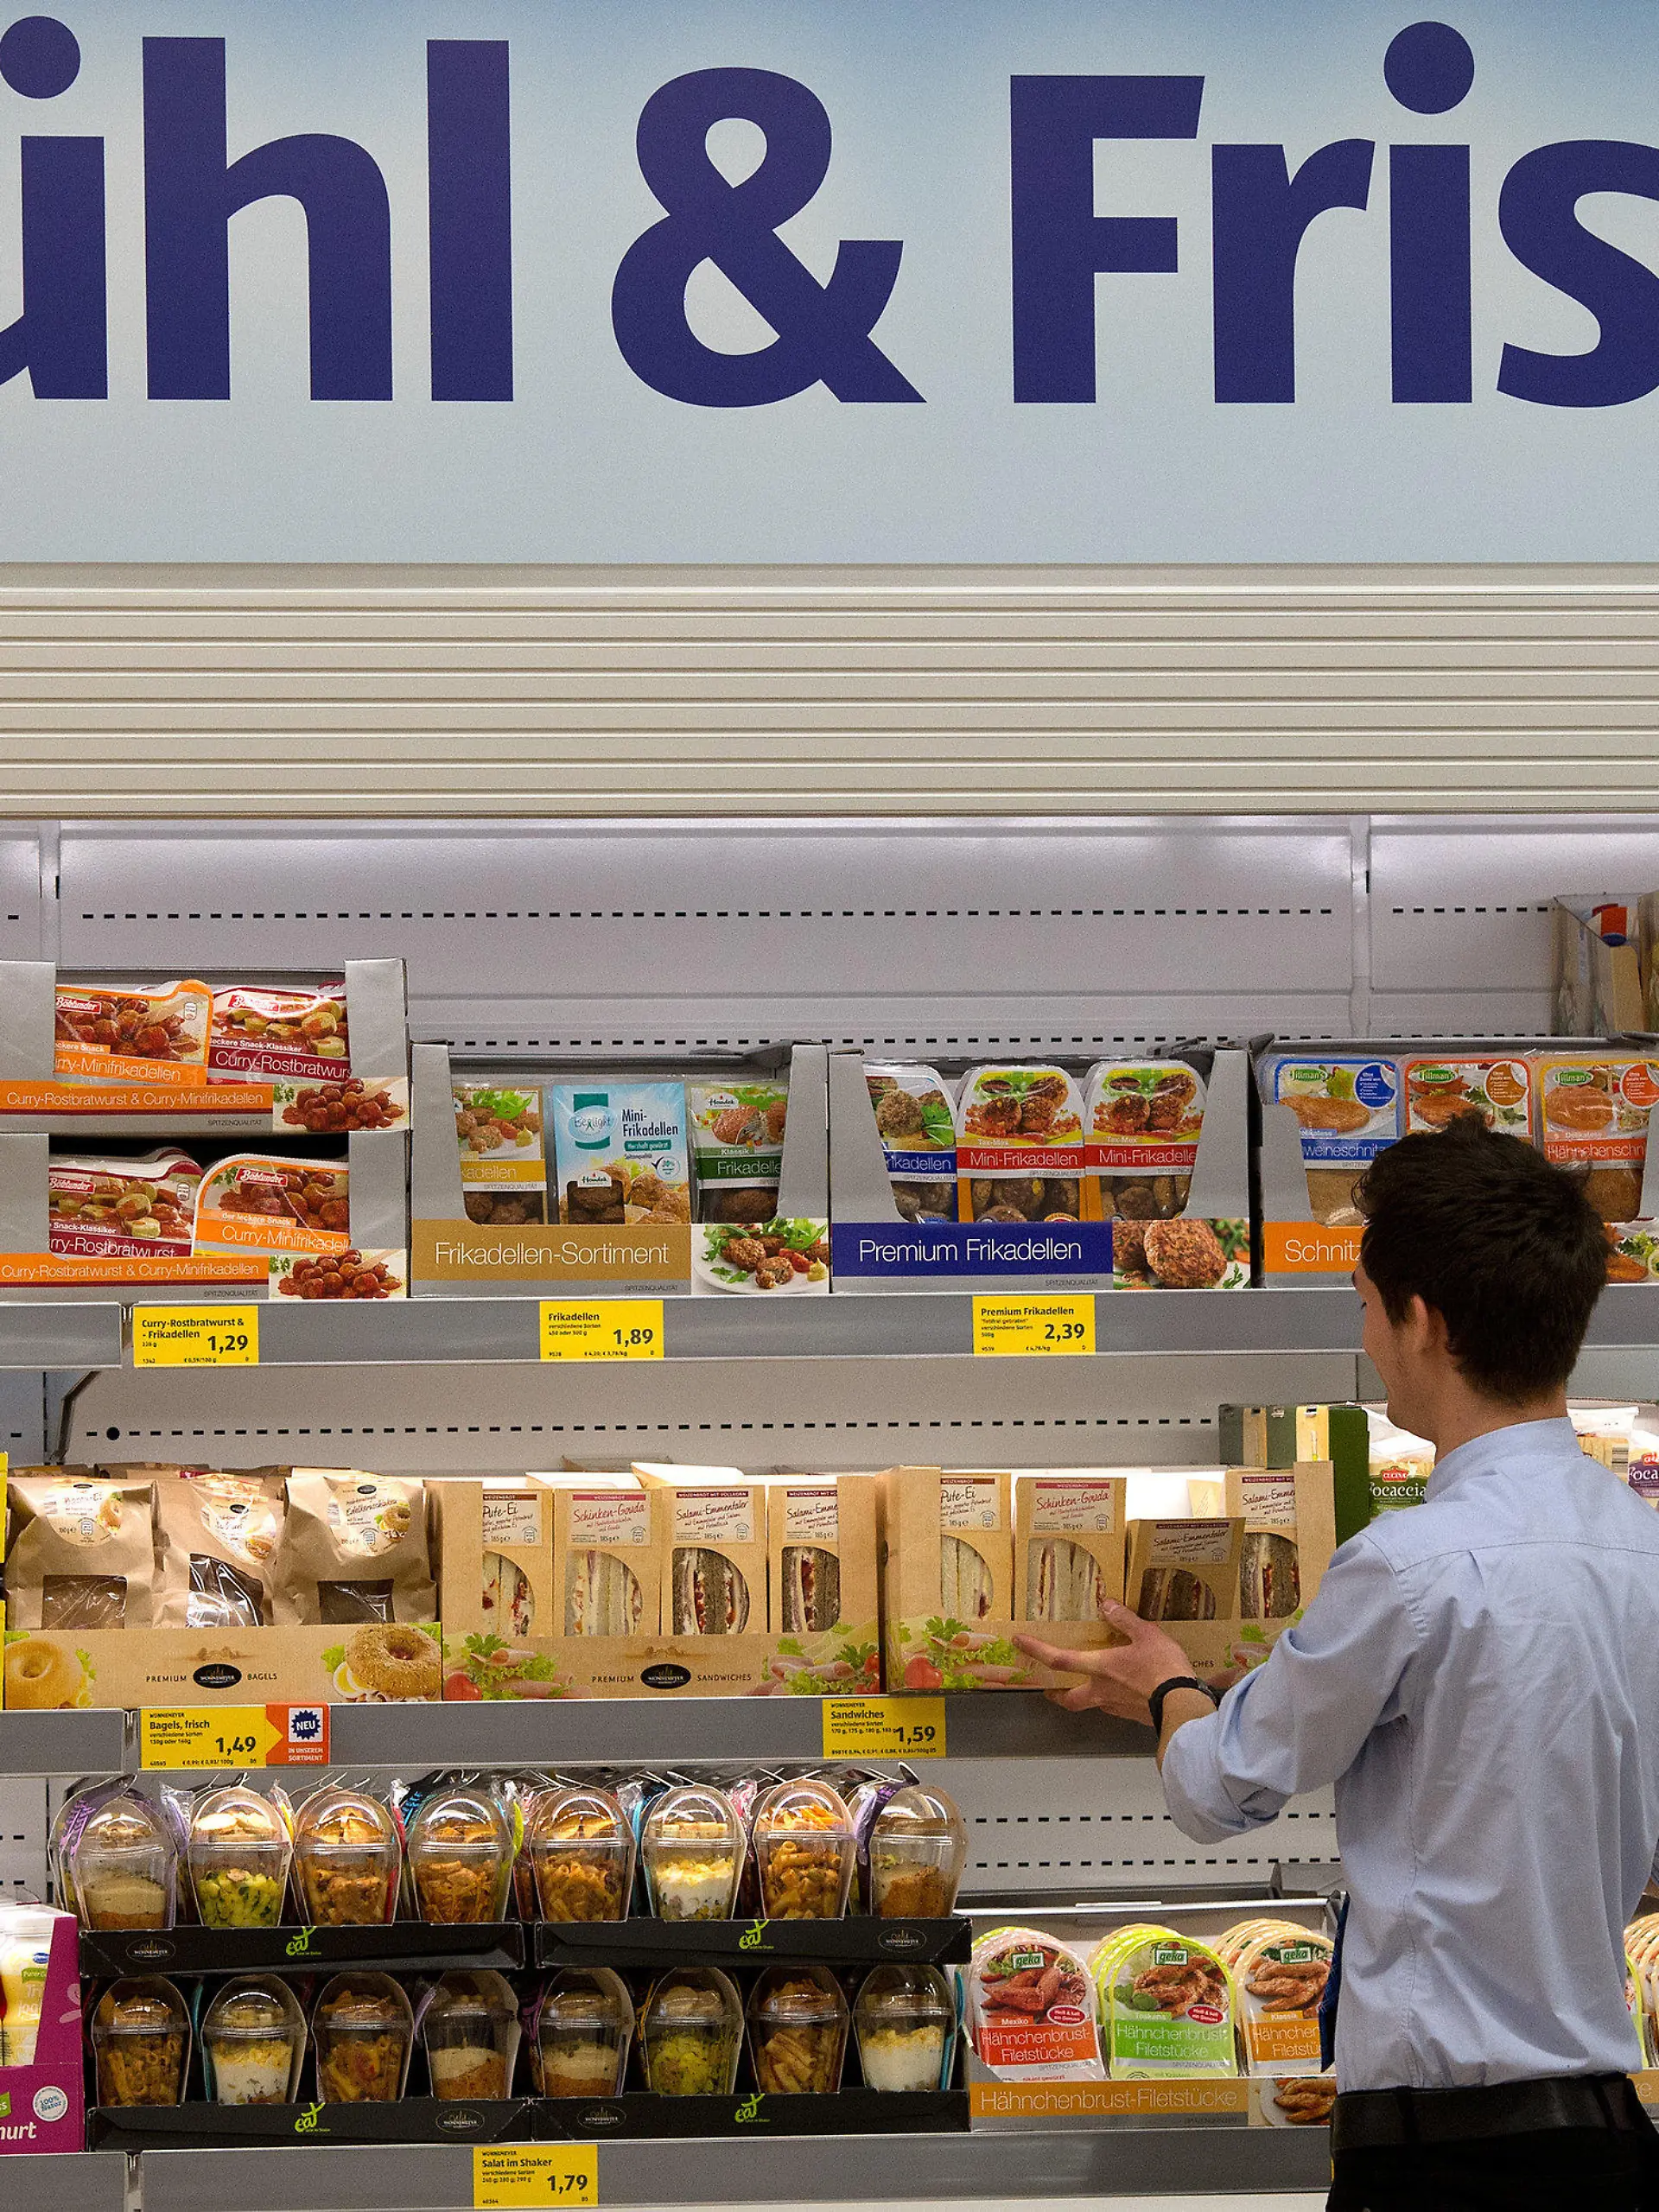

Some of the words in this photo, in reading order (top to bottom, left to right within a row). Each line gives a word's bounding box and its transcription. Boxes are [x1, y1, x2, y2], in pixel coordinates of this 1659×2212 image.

[611, 67, 928, 409] &
[1009, 20, 1659, 410] Fris
[7, 1091, 128, 1107] Curry-Rostbratwurst
[131, 1092, 139, 1105] &
[143, 1091, 264, 1107] Curry-Minifrikadellen
[622, 1109, 647, 1122] Mini-
[623, 1123, 679, 1137] Frikadellen
[970, 1150, 1077, 1166] Mini-Frikadellen
[435, 1241, 670, 1266] Frikadellen-Sortiment
[859, 1239, 957, 1262] Premium
[966, 1238, 1083, 1261] Frikadellen
[2, 1263, 124, 1280] Curry-Rostbratwurst
[127, 1264, 136, 1276] &
[138, 1262, 259, 1277] Curry-Minifrikadellen
[548, 1313, 600, 1321] Frikadellen
[1024, 1306, 1074, 1315] Frikadellen
[142, 1319, 235, 1329] Curry-Rostbratwurst
[1045, 1323, 1085, 1342] 2,39
[207, 1335, 248, 1353] 1,29
[613, 1328, 653, 1347] 1,89
[483, 1502, 518, 1518] Pute-Ei
[1036, 1490, 1109, 1511] Schinken-Gouda
[573, 1502, 645, 1522] Schinken-Gouda
[676, 1500, 748, 1521] Salami-Emmentaler
[830, 1710, 885, 1719] Sandwiches
[149, 1720, 182, 1731] Bagels,
[184, 1719, 210, 1729] frisch
[296, 1720, 315, 1731] NEU
[896, 1726, 936, 1745] 1,59
[215, 1737, 257, 1756] 1,49
[286, 1926, 316, 1956] eat
[739, 1919, 770, 1950] eat
[982, 2027, 1091, 2046] Hähnchenbrust-
[1001, 2046, 1074, 2063] Filetstücke
[1135, 2041, 1209, 2057] Filetstücke
[735, 2093, 766, 2124] eat
[981, 2087, 1237, 2111] Hähnchenbrust-Filetstücke
[295, 2102, 326, 2133] eat
[482, 2158, 505, 2167] Salat
[506, 2158, 518, 2167] im
[520, 2158, 552, 2167] Shaker
[547, 2175, 588, 2194] 1,79
